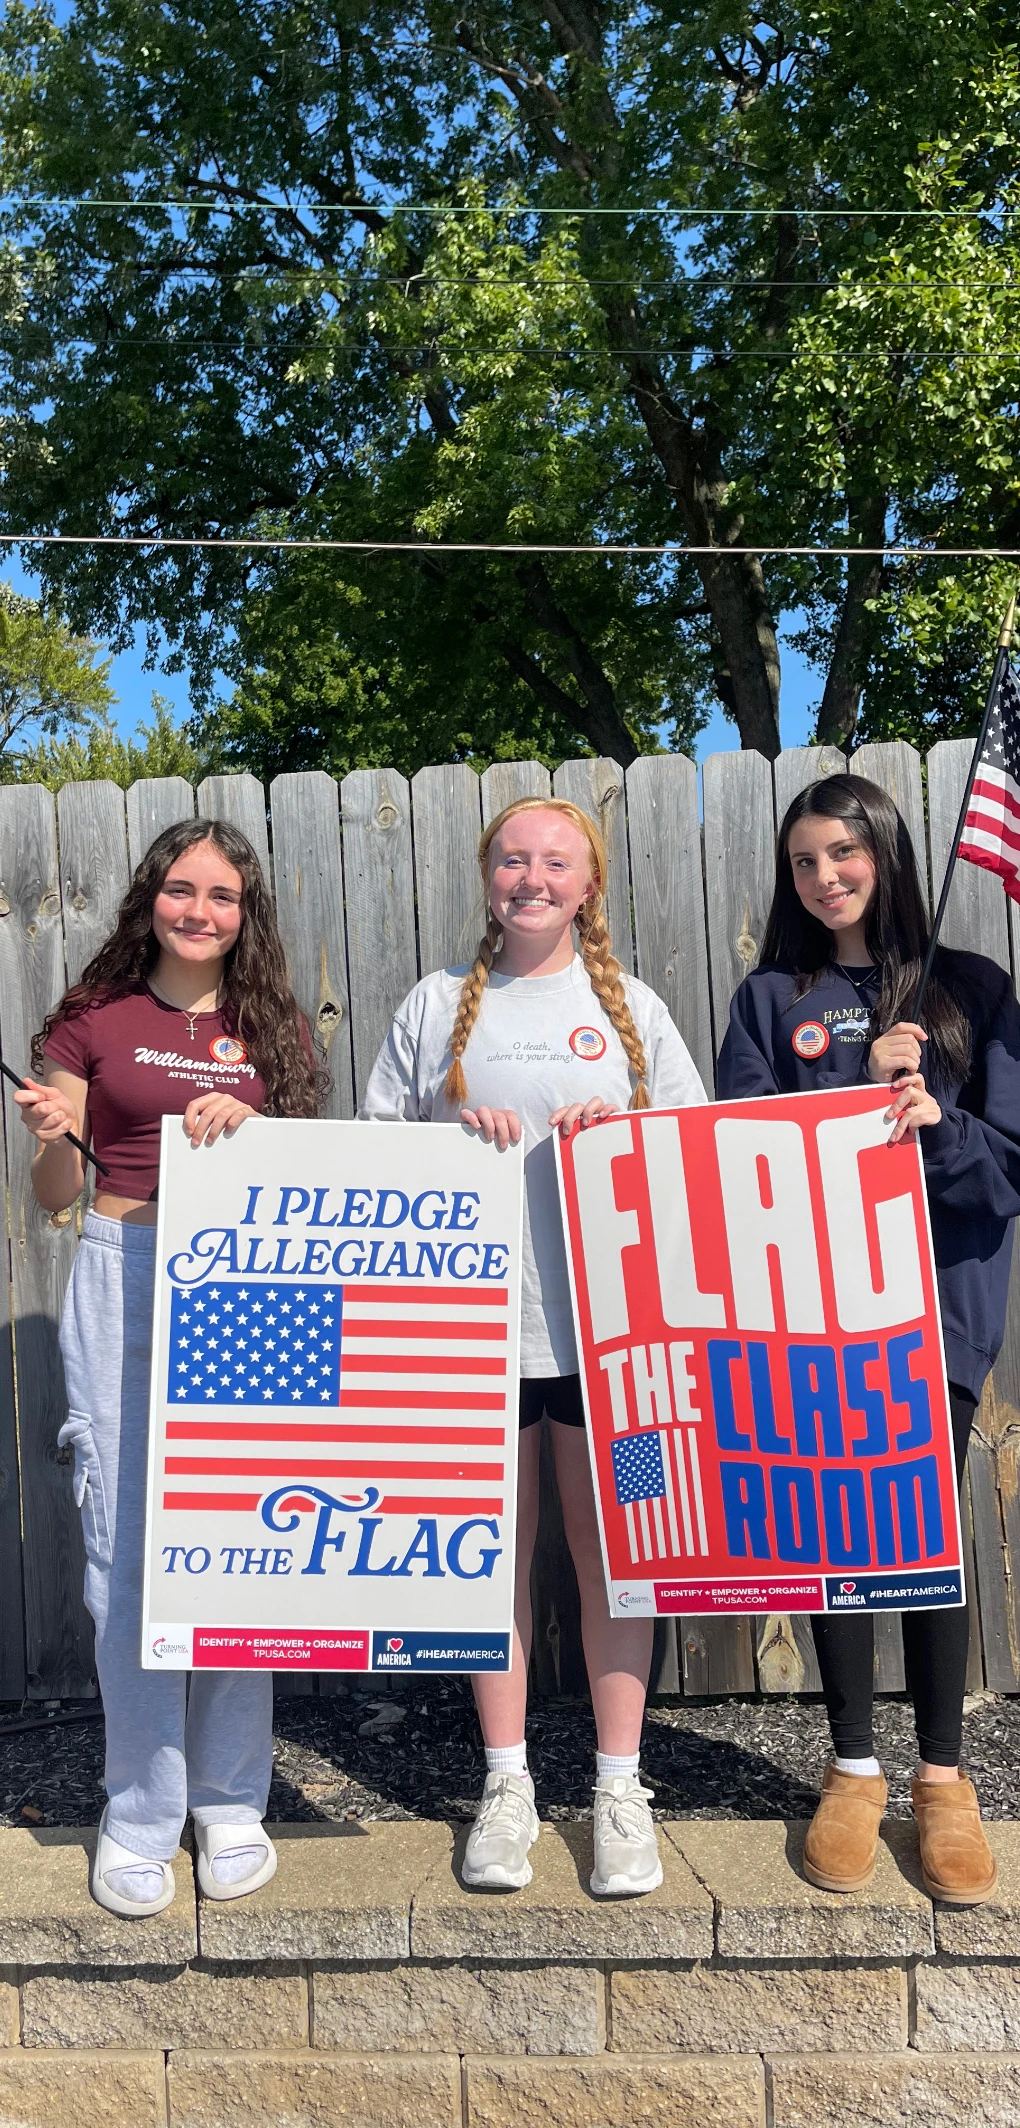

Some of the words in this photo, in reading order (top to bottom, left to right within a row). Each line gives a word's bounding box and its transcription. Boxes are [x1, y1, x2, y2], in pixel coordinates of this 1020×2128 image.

[512, 1041, 521, 1050] O
[523, 1041, 551, 1052] death,
[486, 1051, 513, 1062] where
[515, 1050, 524, 1061] is
[524, 1052, 548, 1064] your
[548, 1051, 576, 1064] sting?
[168, 1071, 214, 1082] ATHLETIC
[215, 1076, 240, 1085] CLUB
[195, 1081, 214, 1089] 1998
[240, 1185, 264, 1226] I
[272, 1186, 481, 1231] PLEDGE
[571, 1105, 926, 1345] FLAG
[166, 1227, 510, 1285] ALLEGIANCE
[599, 1340, 702, 1434] THE
[706, 1328, 934, 1458] CLASS
[719, 1453, 946, 1567] ROOM
[162, 1546, 212, 1575] TO
[219, 1547, 294, 1576] THE
[261, 1484, 503, 1580] FLAG
[660, 1588, 703, 1598] IDENTIFY
[711, 1587, 760, 1596] EMPOWER
[768, 1586, 818, 1595] ORGANIZE
[869, 1584, 958, 1598] #iHEARTAMERICA
[712, 1596, 768, 1605] TPUSA.COM
[832, 1594, 866, 1606] AMERICA
[199, 1637, 245, 1647] IDENTIFY
[253, 1638, 304, 1649] EMPOWER
[312, 1639, 364, 1650] ORGANIZE
[253, 1650, 311, 1659] TPUSA.COM
[377, 1653, 412, 1666] AMERICA
[415, 1649, 505, 1660] #iHEARTAMERICA
